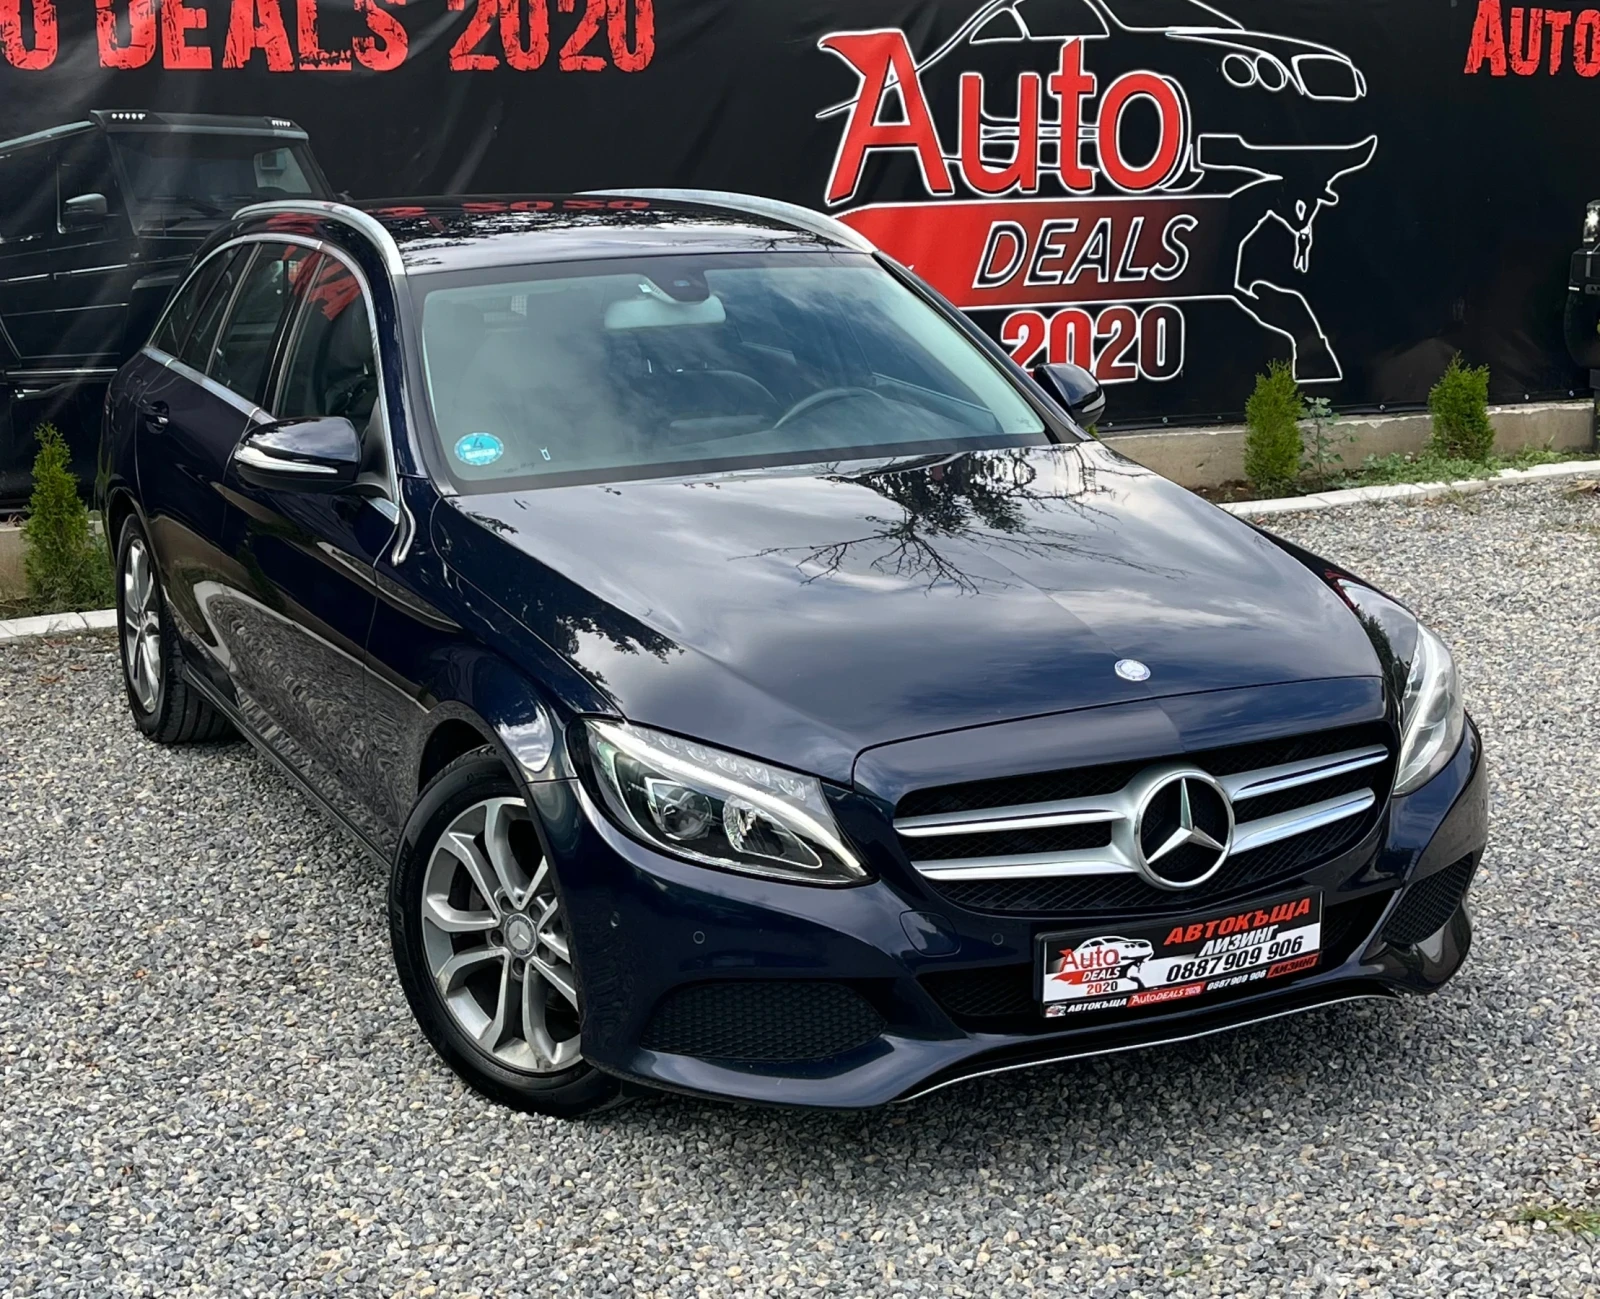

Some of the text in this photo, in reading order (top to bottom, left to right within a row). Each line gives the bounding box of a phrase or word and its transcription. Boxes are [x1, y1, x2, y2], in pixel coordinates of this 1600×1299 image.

[96, 0, 409, 72] DEALS
[448, 0, 655, 72] 2020
[817, 28, 1184, 205] Auto
[971, 213, 1199, 290] DEALS
[1002, 303, 1186, 385] 2020
[1163, 897, 1311, 946] АВТОКЪЩА
[1198, 924, 1279, 957] ЛИЗИНГ
[1059, 946, 1120, 972] Auto
[1081, 967, 1121, 982] DEALS
[1166, 935, 1304, 983] 0887 909 906
[1086, 981, 1119, 995] 2020
